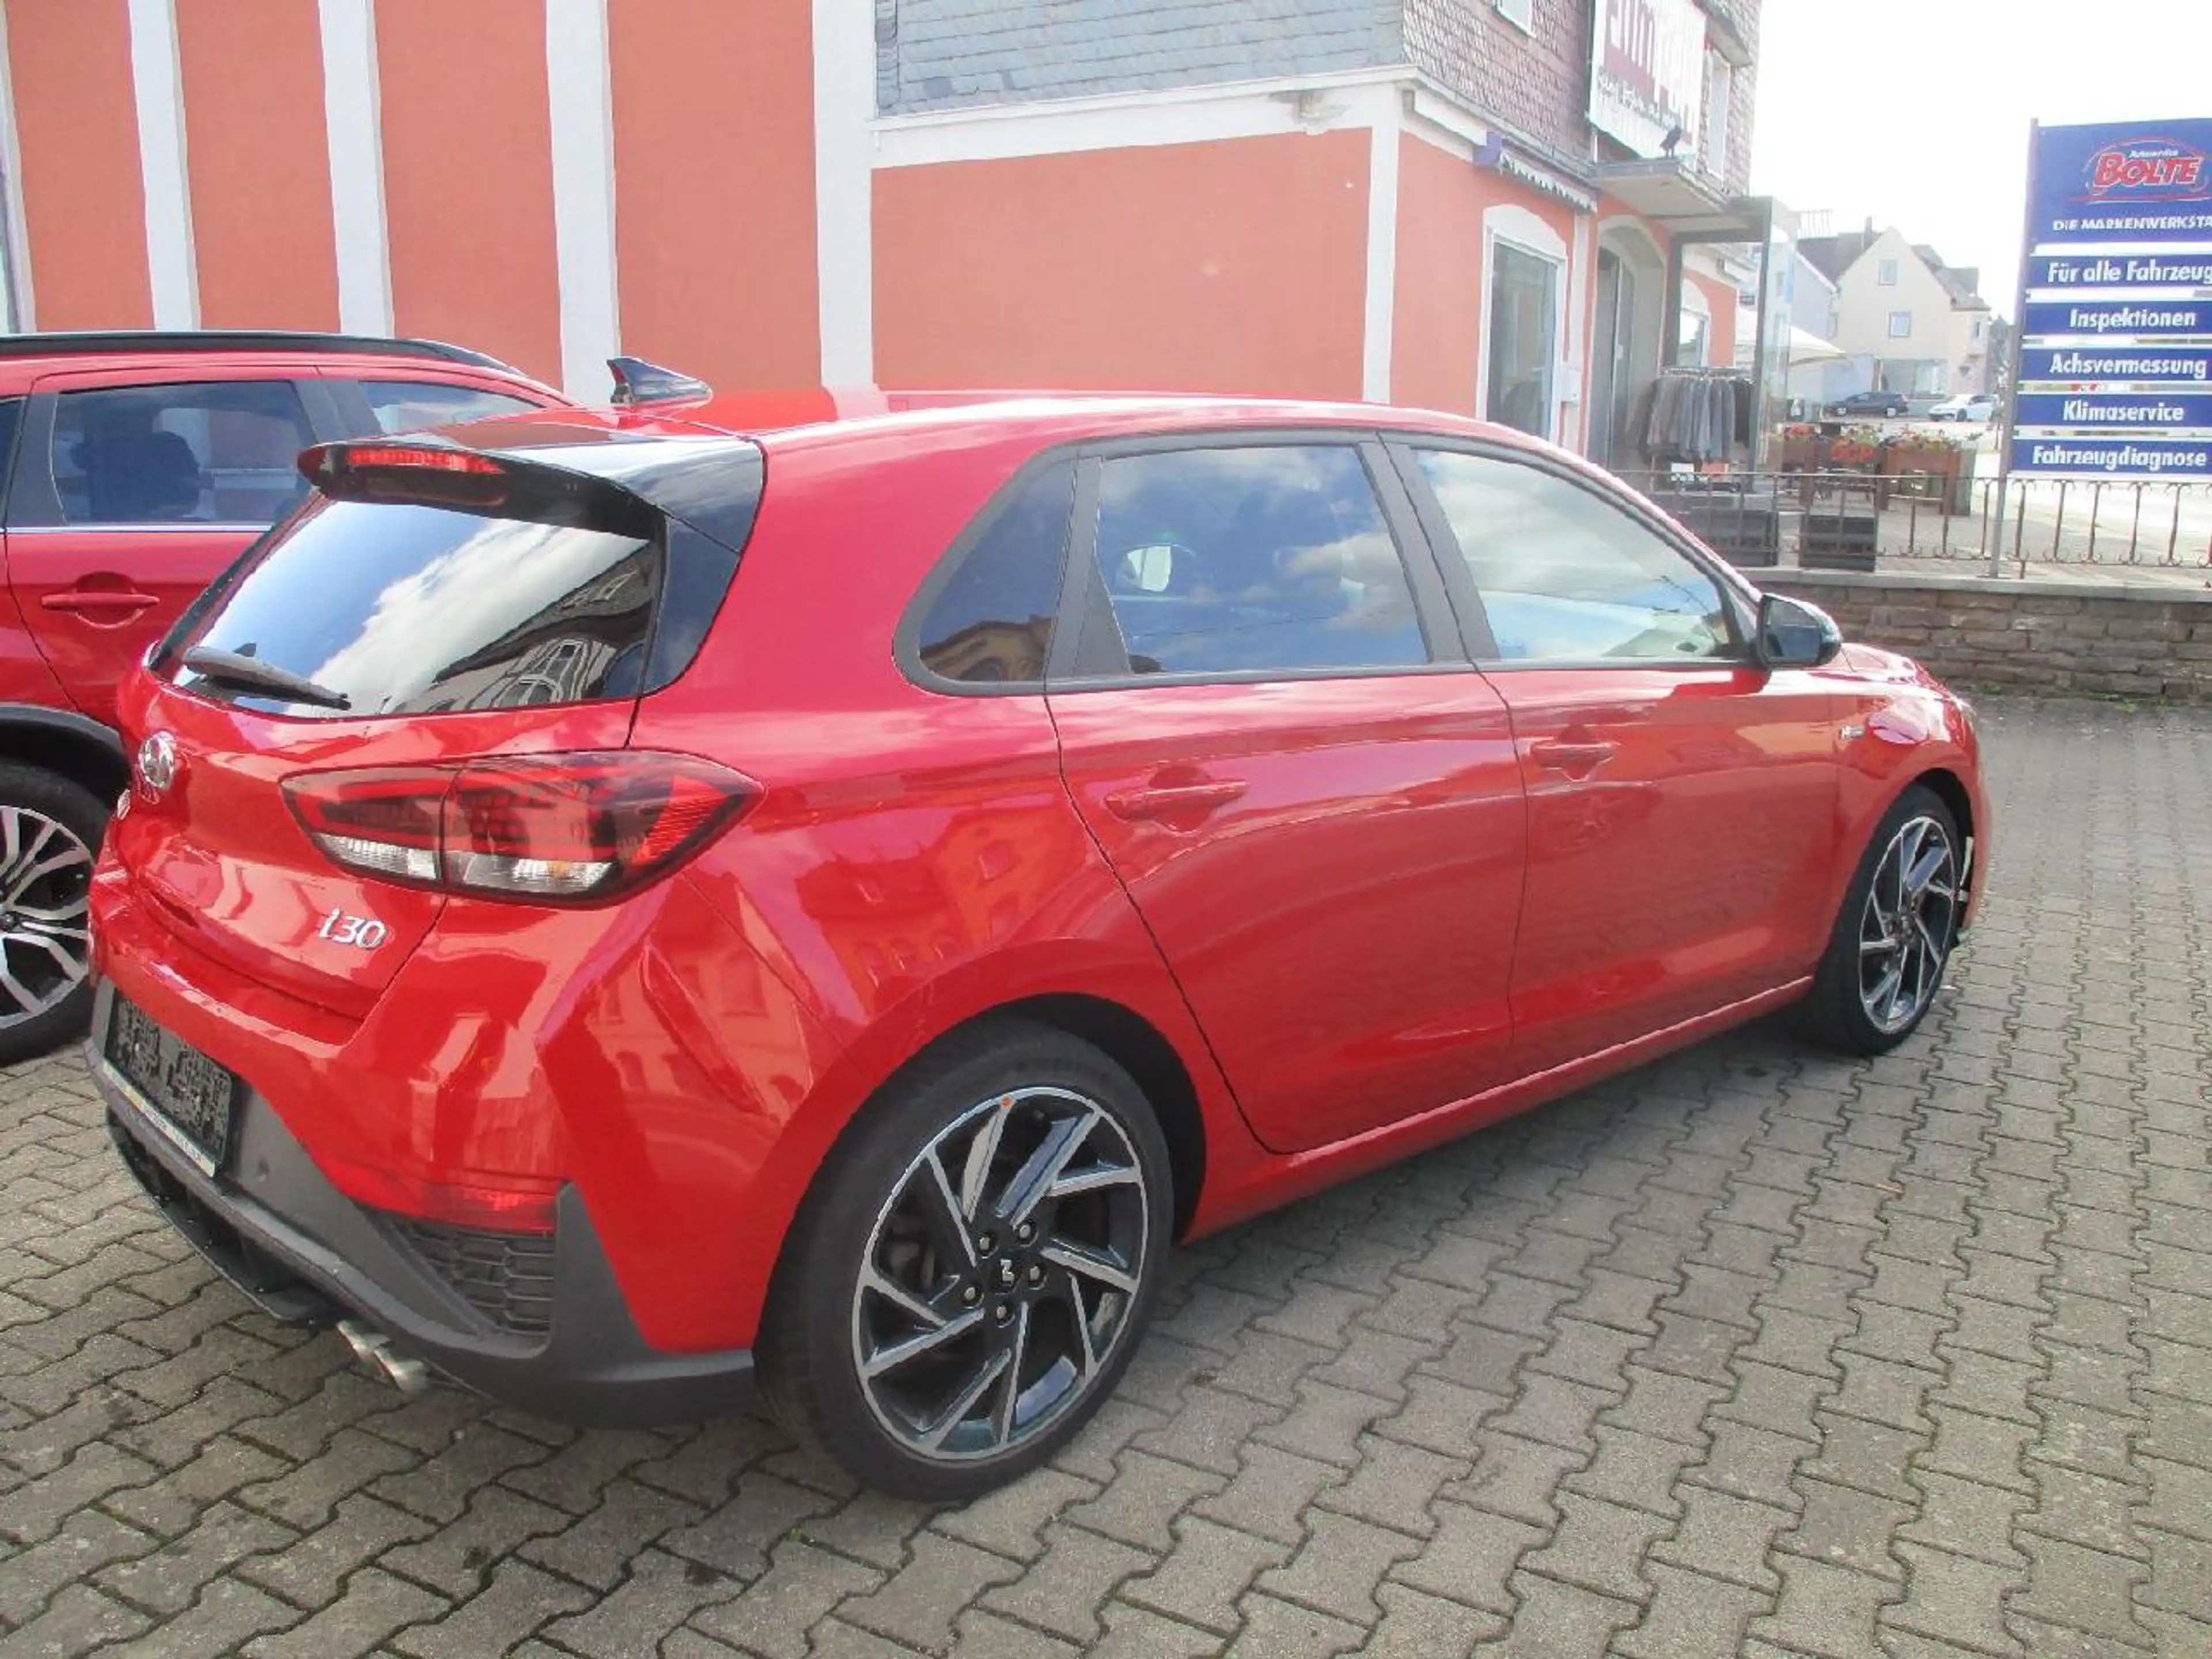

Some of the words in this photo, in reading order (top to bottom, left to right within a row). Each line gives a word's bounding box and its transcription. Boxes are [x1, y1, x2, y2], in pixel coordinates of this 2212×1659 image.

[2093, 152, 2203, 187] BOLTE
[2053, 219, 2078, 230] DIE
[2047, 262, 2080, 282] Für
[2083, 260, 2122, 282] alle
[2126, 259, 2212, 285] Fahrzeug
[2070, 308, 2196, 332] Inspektionen
[2049, 352, 2207, 380] Achsvermessung
[2063, 400, 2184, 421] Klimaservice
[2032, 445, 2207, 471] Fahrzeugdiagnose
[319, 908, 387, 948] i30
